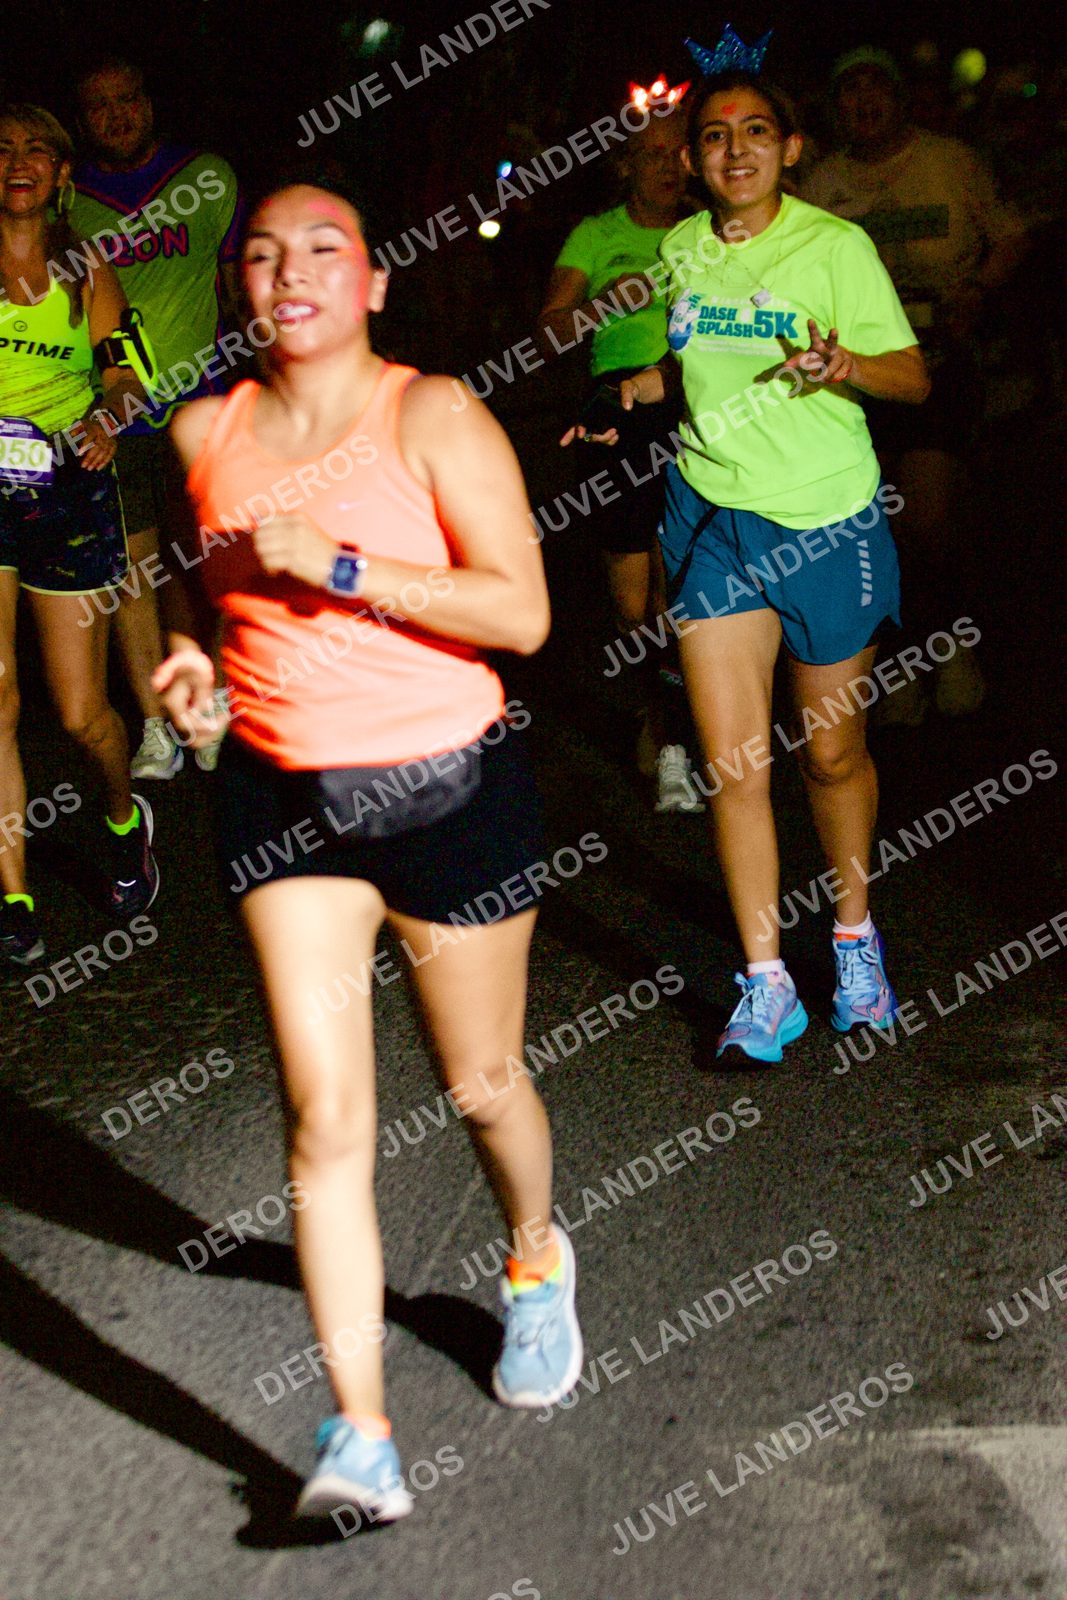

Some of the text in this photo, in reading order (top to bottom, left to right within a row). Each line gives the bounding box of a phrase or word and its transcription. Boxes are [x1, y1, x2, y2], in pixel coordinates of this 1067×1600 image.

[699, 306, 738, 320] DASH
[696, 321, 753, 338] SPLASH
[754, 309, 798, 338] 5K
